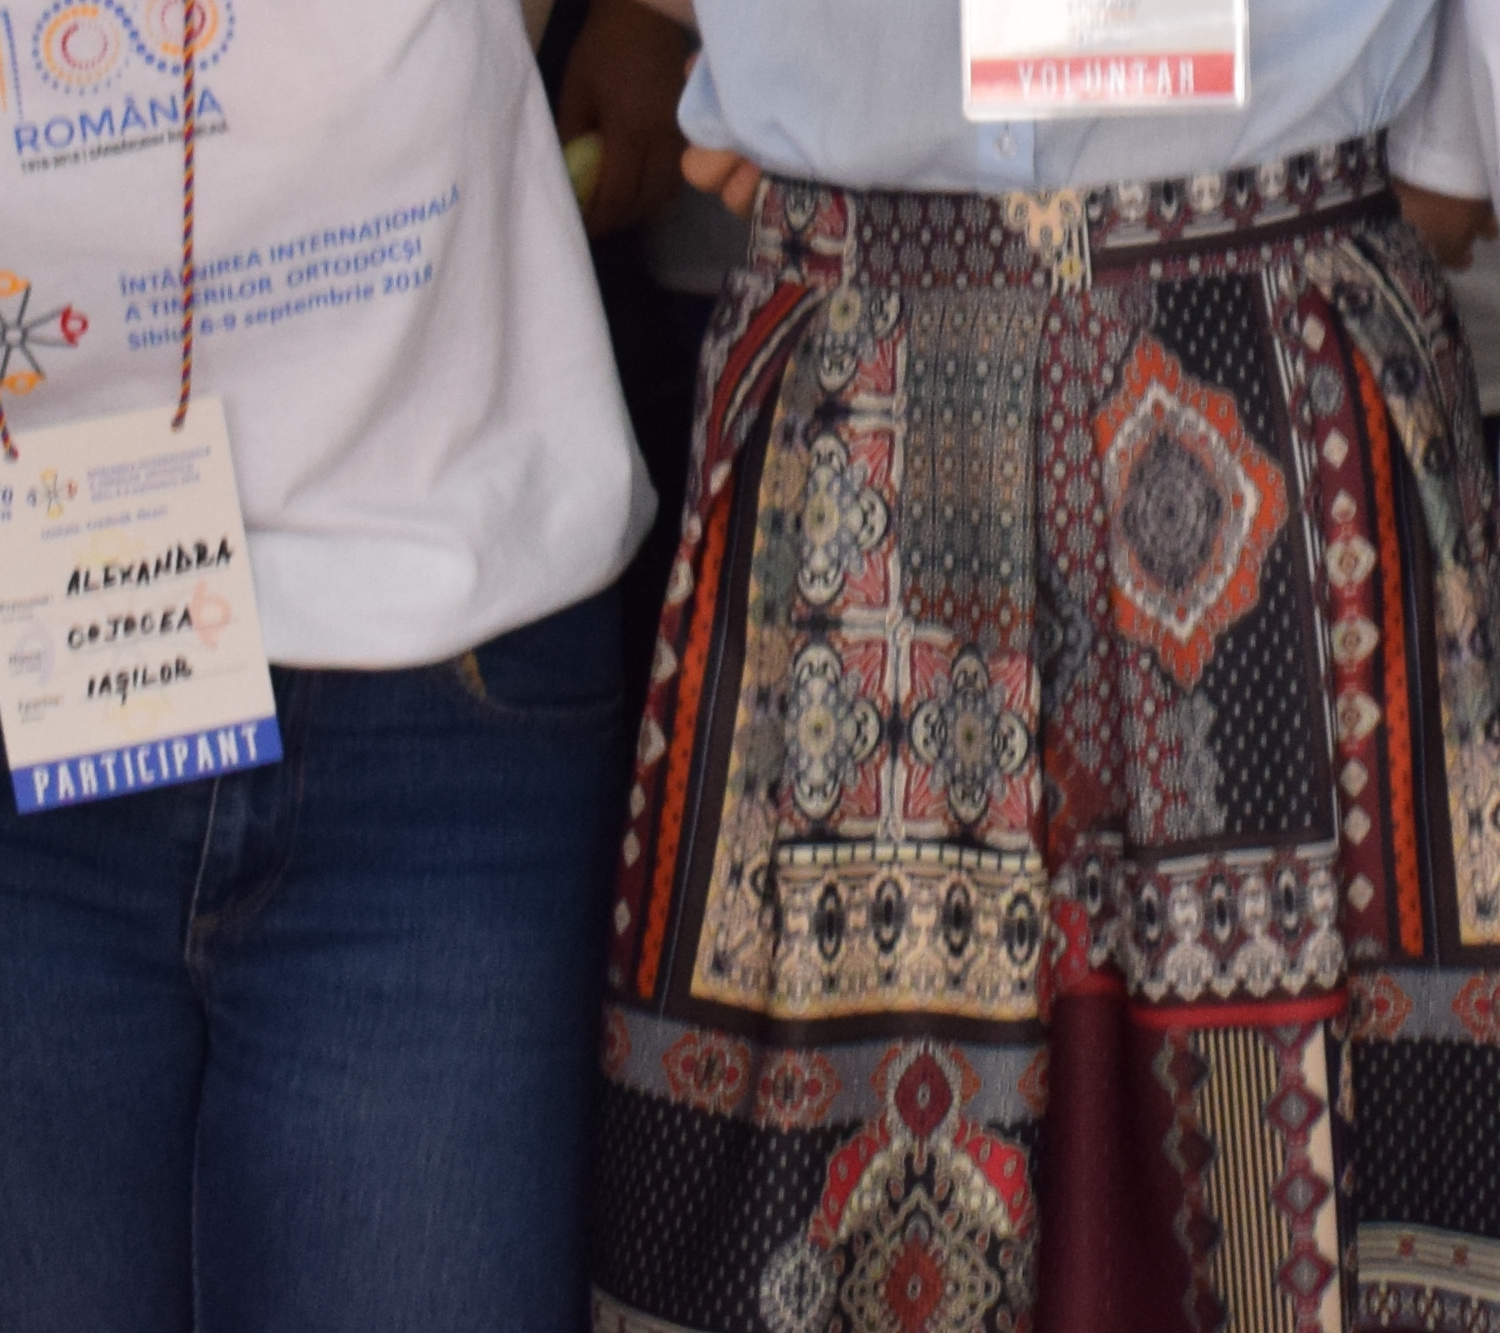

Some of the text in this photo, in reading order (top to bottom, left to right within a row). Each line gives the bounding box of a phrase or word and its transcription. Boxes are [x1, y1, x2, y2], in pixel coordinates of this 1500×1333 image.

[14, 85, 224, 155] ROMÂNA
[124, 303, 142, 323] A
[66, 533, 233, 597] ALEXANDRA
[32, 724, 259, 806] PARTICIPANT
